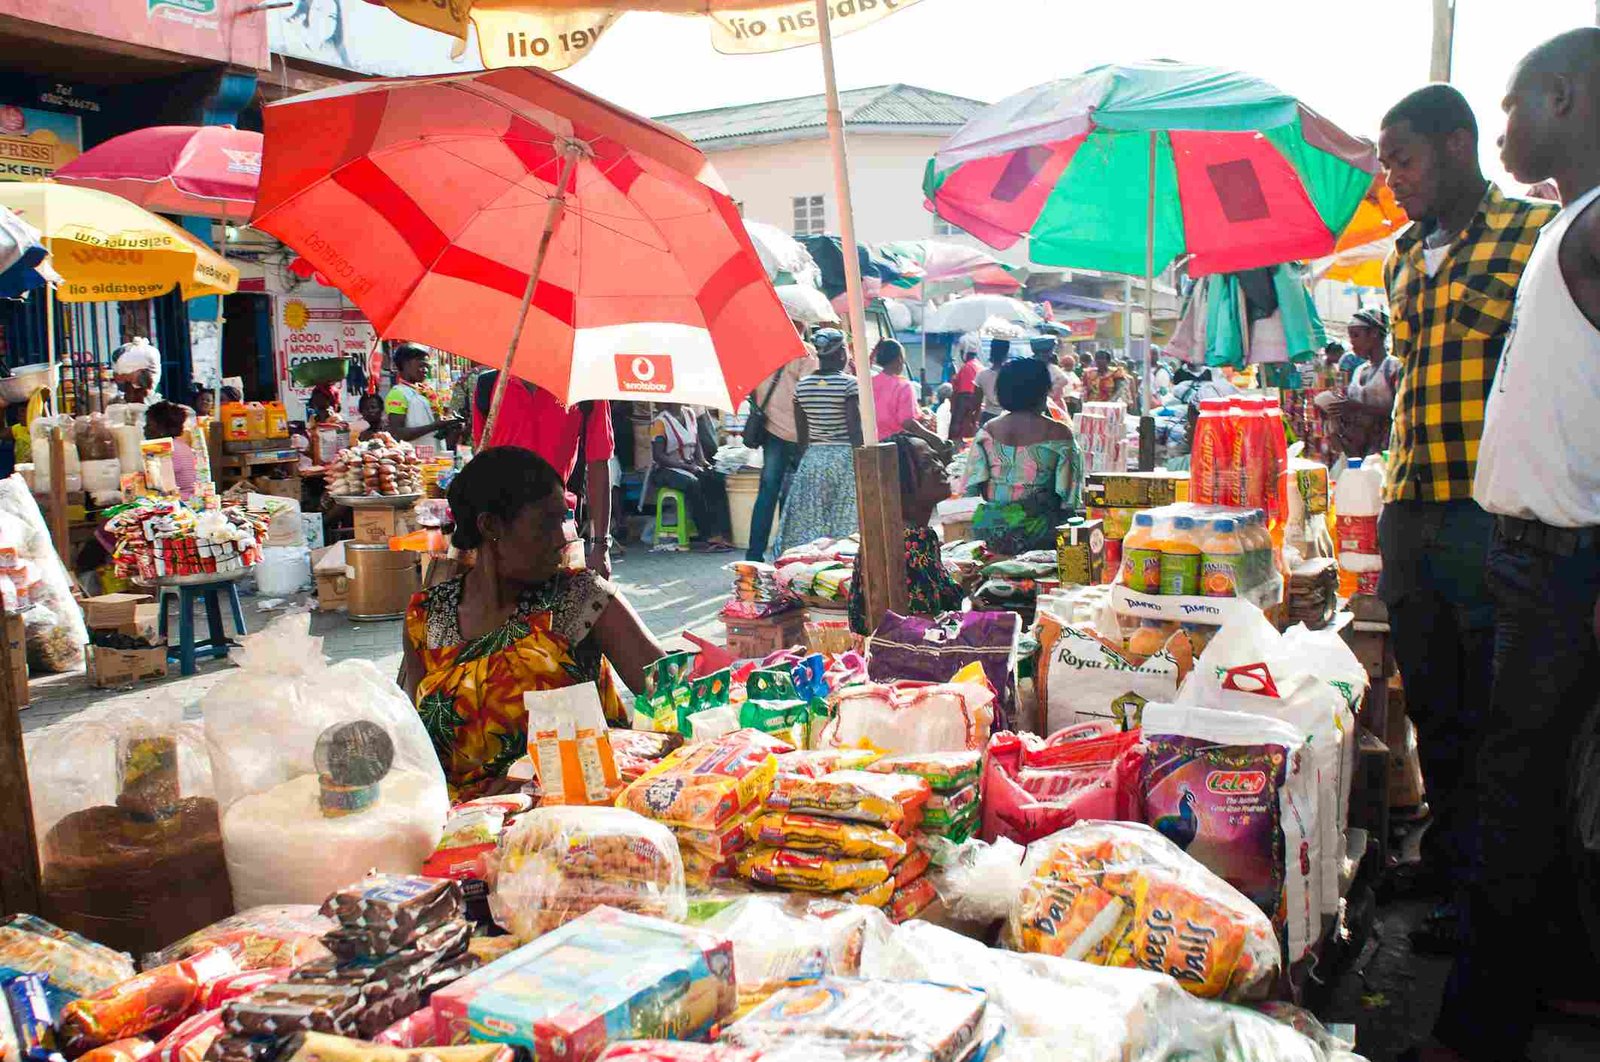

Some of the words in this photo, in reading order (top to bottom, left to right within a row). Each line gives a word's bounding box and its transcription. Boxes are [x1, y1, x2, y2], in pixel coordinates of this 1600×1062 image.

[290, 333, 320, 342] GOOD
[290, 344, 334, 354] MORNING
[1138, 908, 1176, 973] heese
[1168, 919, 1217, 984] Balls
